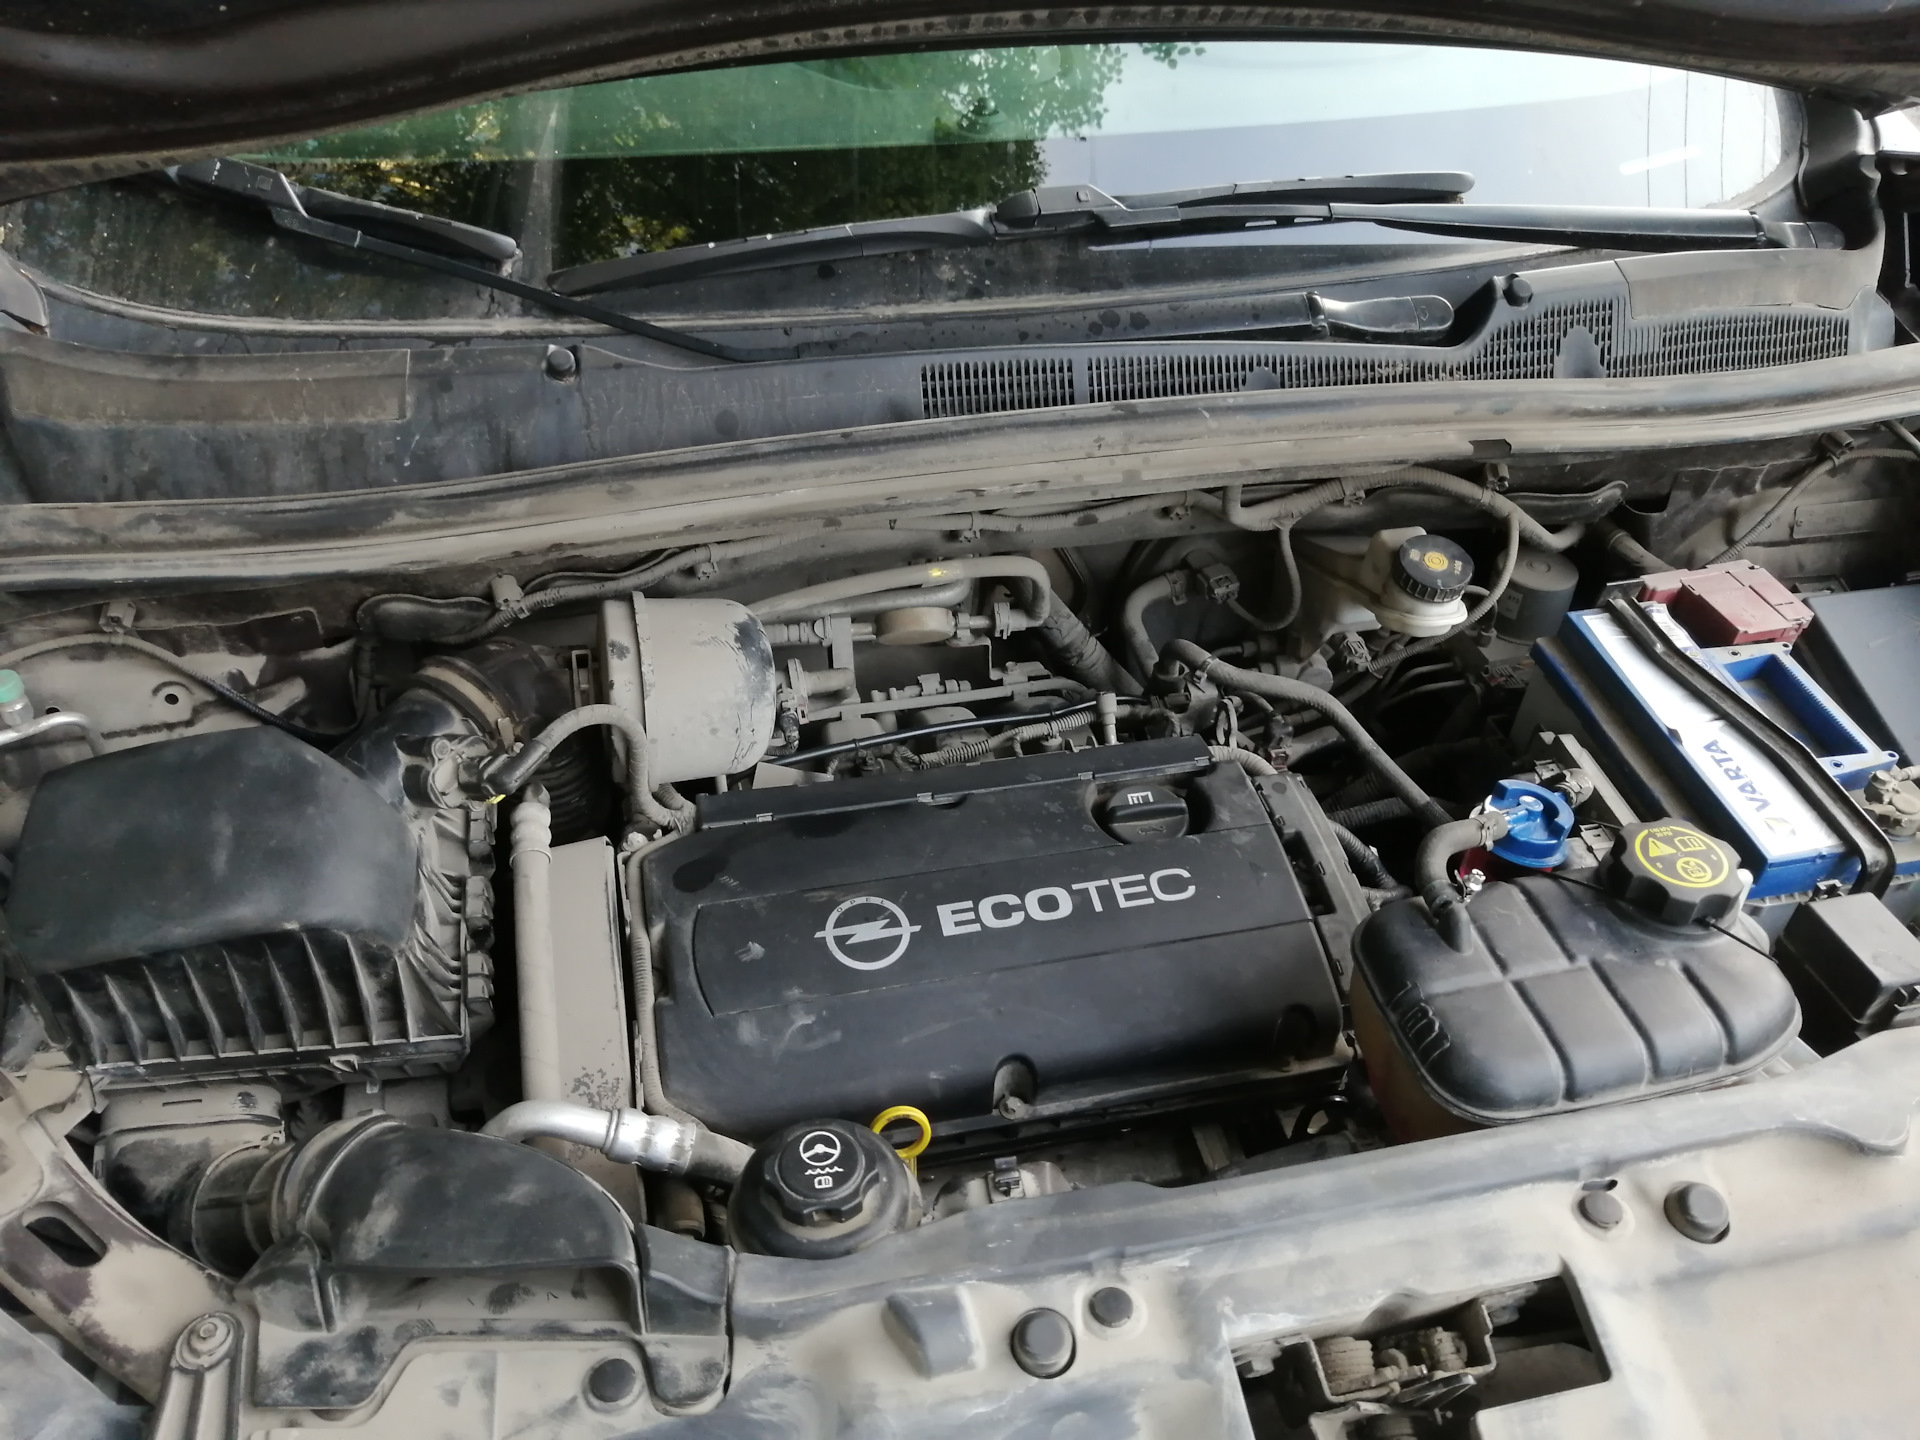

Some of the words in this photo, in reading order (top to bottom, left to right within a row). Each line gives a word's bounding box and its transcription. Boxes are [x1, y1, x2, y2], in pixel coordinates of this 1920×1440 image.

[1703, 739, 1771, 813] VARTA
[836, 897, 886, 913] OPEL
[936, 868, 1196, 937] ECOTEC
